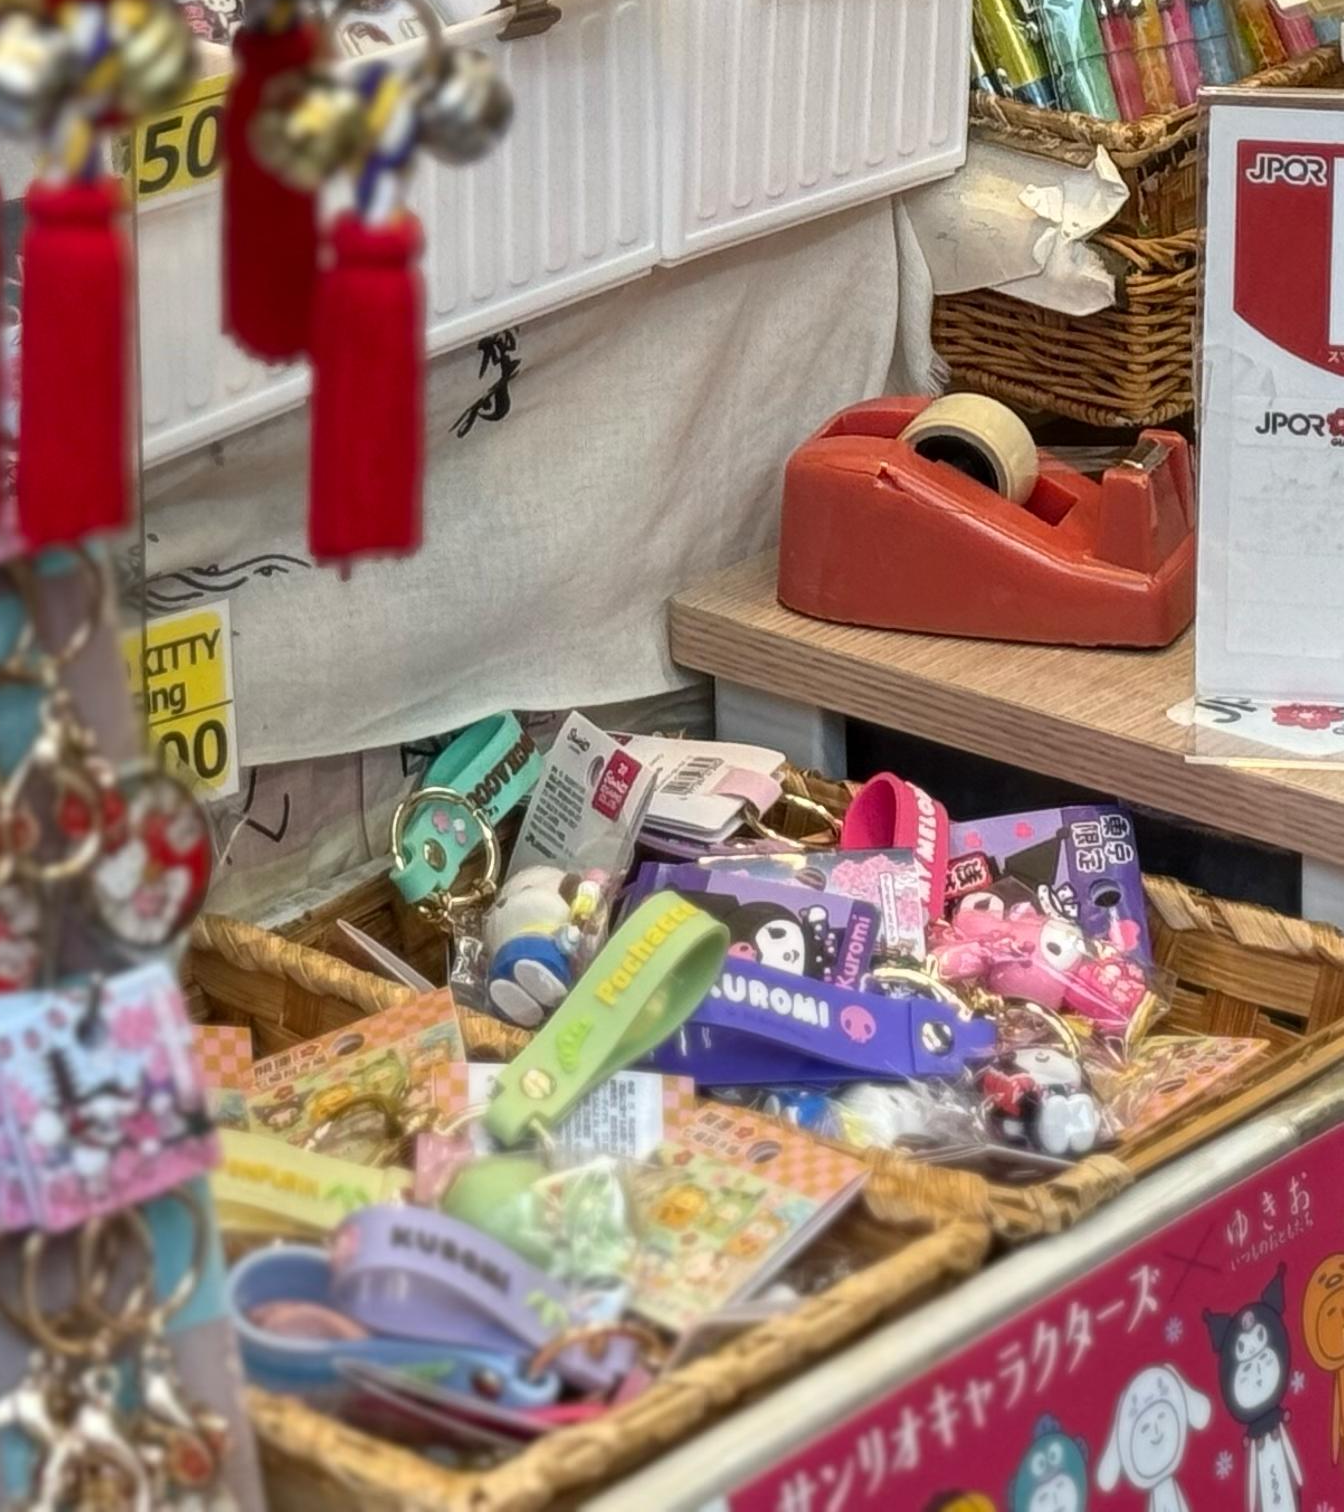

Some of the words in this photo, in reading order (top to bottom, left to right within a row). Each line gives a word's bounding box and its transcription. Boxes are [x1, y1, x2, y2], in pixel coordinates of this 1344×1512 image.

[124, 104, 223, 192] 50
[1246, 154, 1329, 186] JPQR
[1254, 409, 1326, 440] JPQR
[144, 682, 188, 716] ing
[162, 718, 229, 780] 00
[835, 913, 872, 990] Kuromi
[1224, 1170, 1312, 1248] ゆきお
[773, 1263, 1165, 1511] サンリオキャラクターズ
